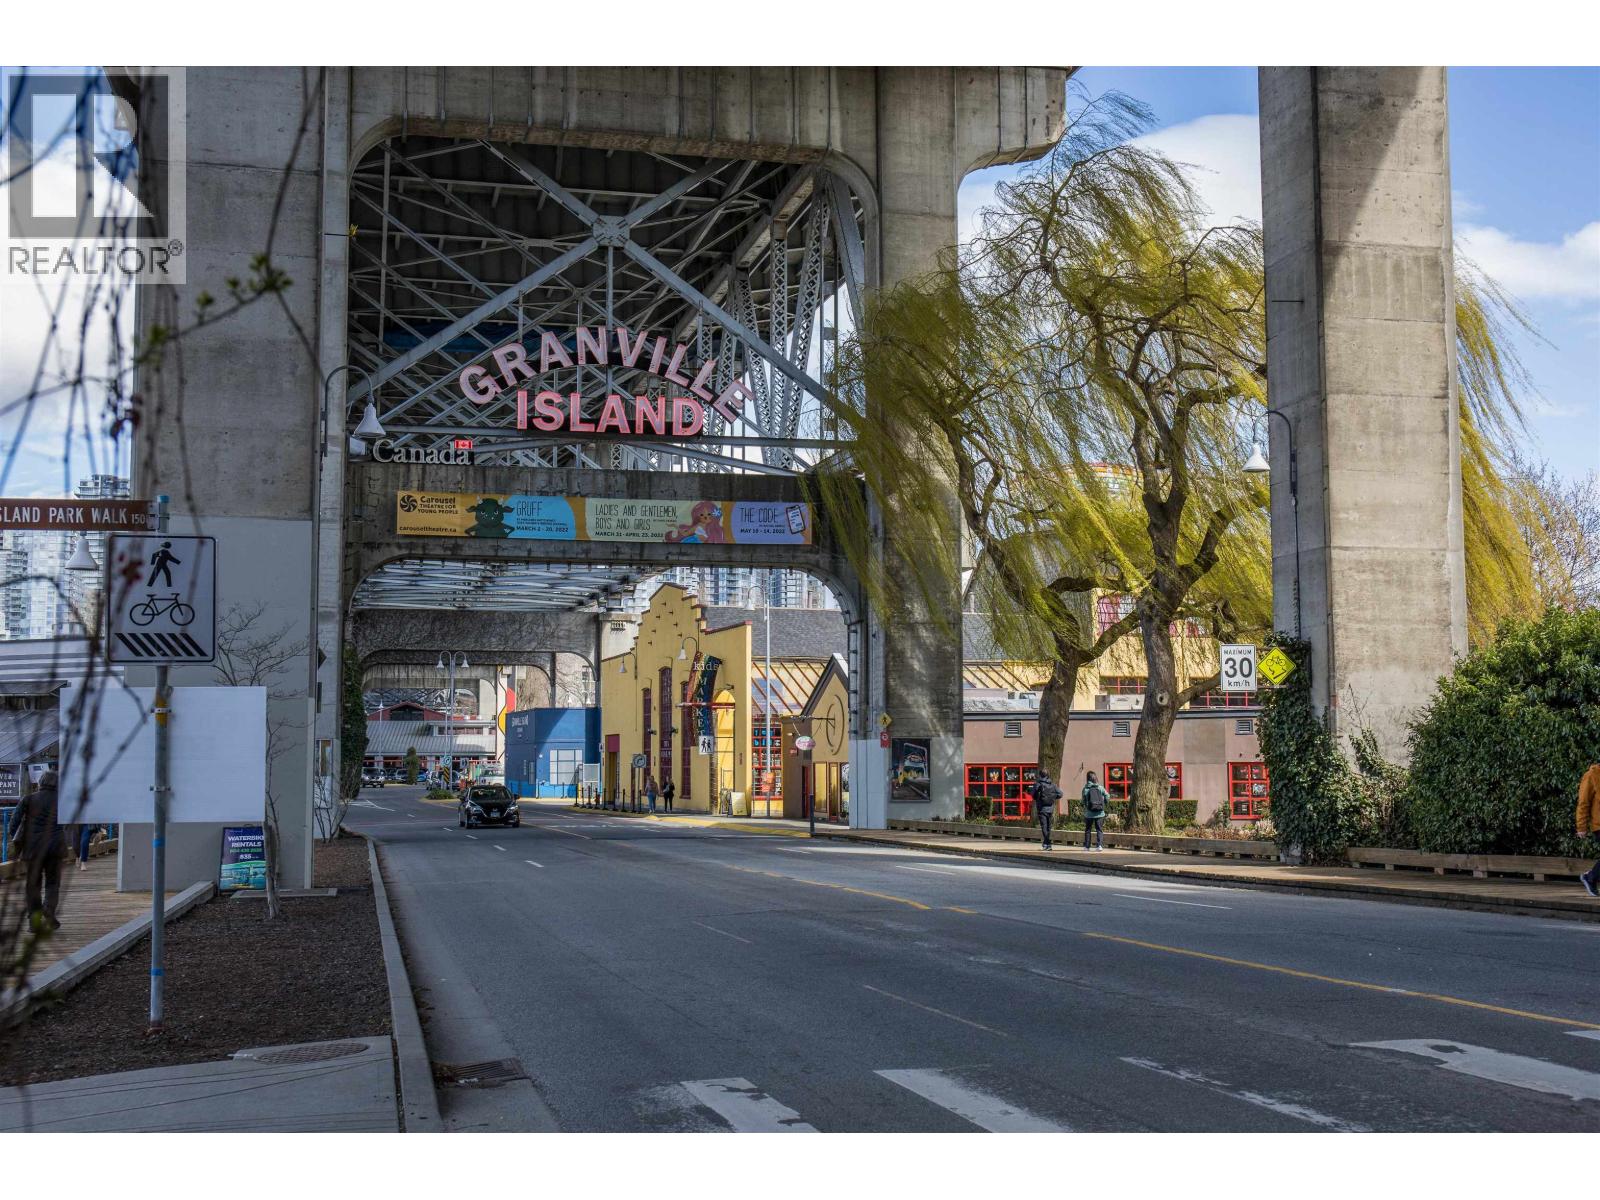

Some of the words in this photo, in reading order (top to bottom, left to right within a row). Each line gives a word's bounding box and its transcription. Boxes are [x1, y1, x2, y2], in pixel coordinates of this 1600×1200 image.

[459, 326, 755, 424] GRANVILLE
[517, 390, 705, 436] ISLAND
[372, 438, 471, 466] Canada
[420, 496, 456, 504] Carousel
[516, 500, 543, 517] GRUFF
[0, 506, 40, 523] LAND
[48, 507, 84, 524] PARK
[91, 507, 127, 524] WALK
[595, 504, 619, 517] LADIES
[622, 504, 638, 517] AND
[640, 505, 678, 519] GENTLEMEN,
[740, 507, 754, 523] THE
[758, 507, 779, 523] CODE
[595, 517, 613, 530] BOYS
[616, 518, 631, 530] AND
[633, 518, 651, 531] GIRLS
[693, 661, 719, 671] kids
[1224, 657, 1253, 678] 30
